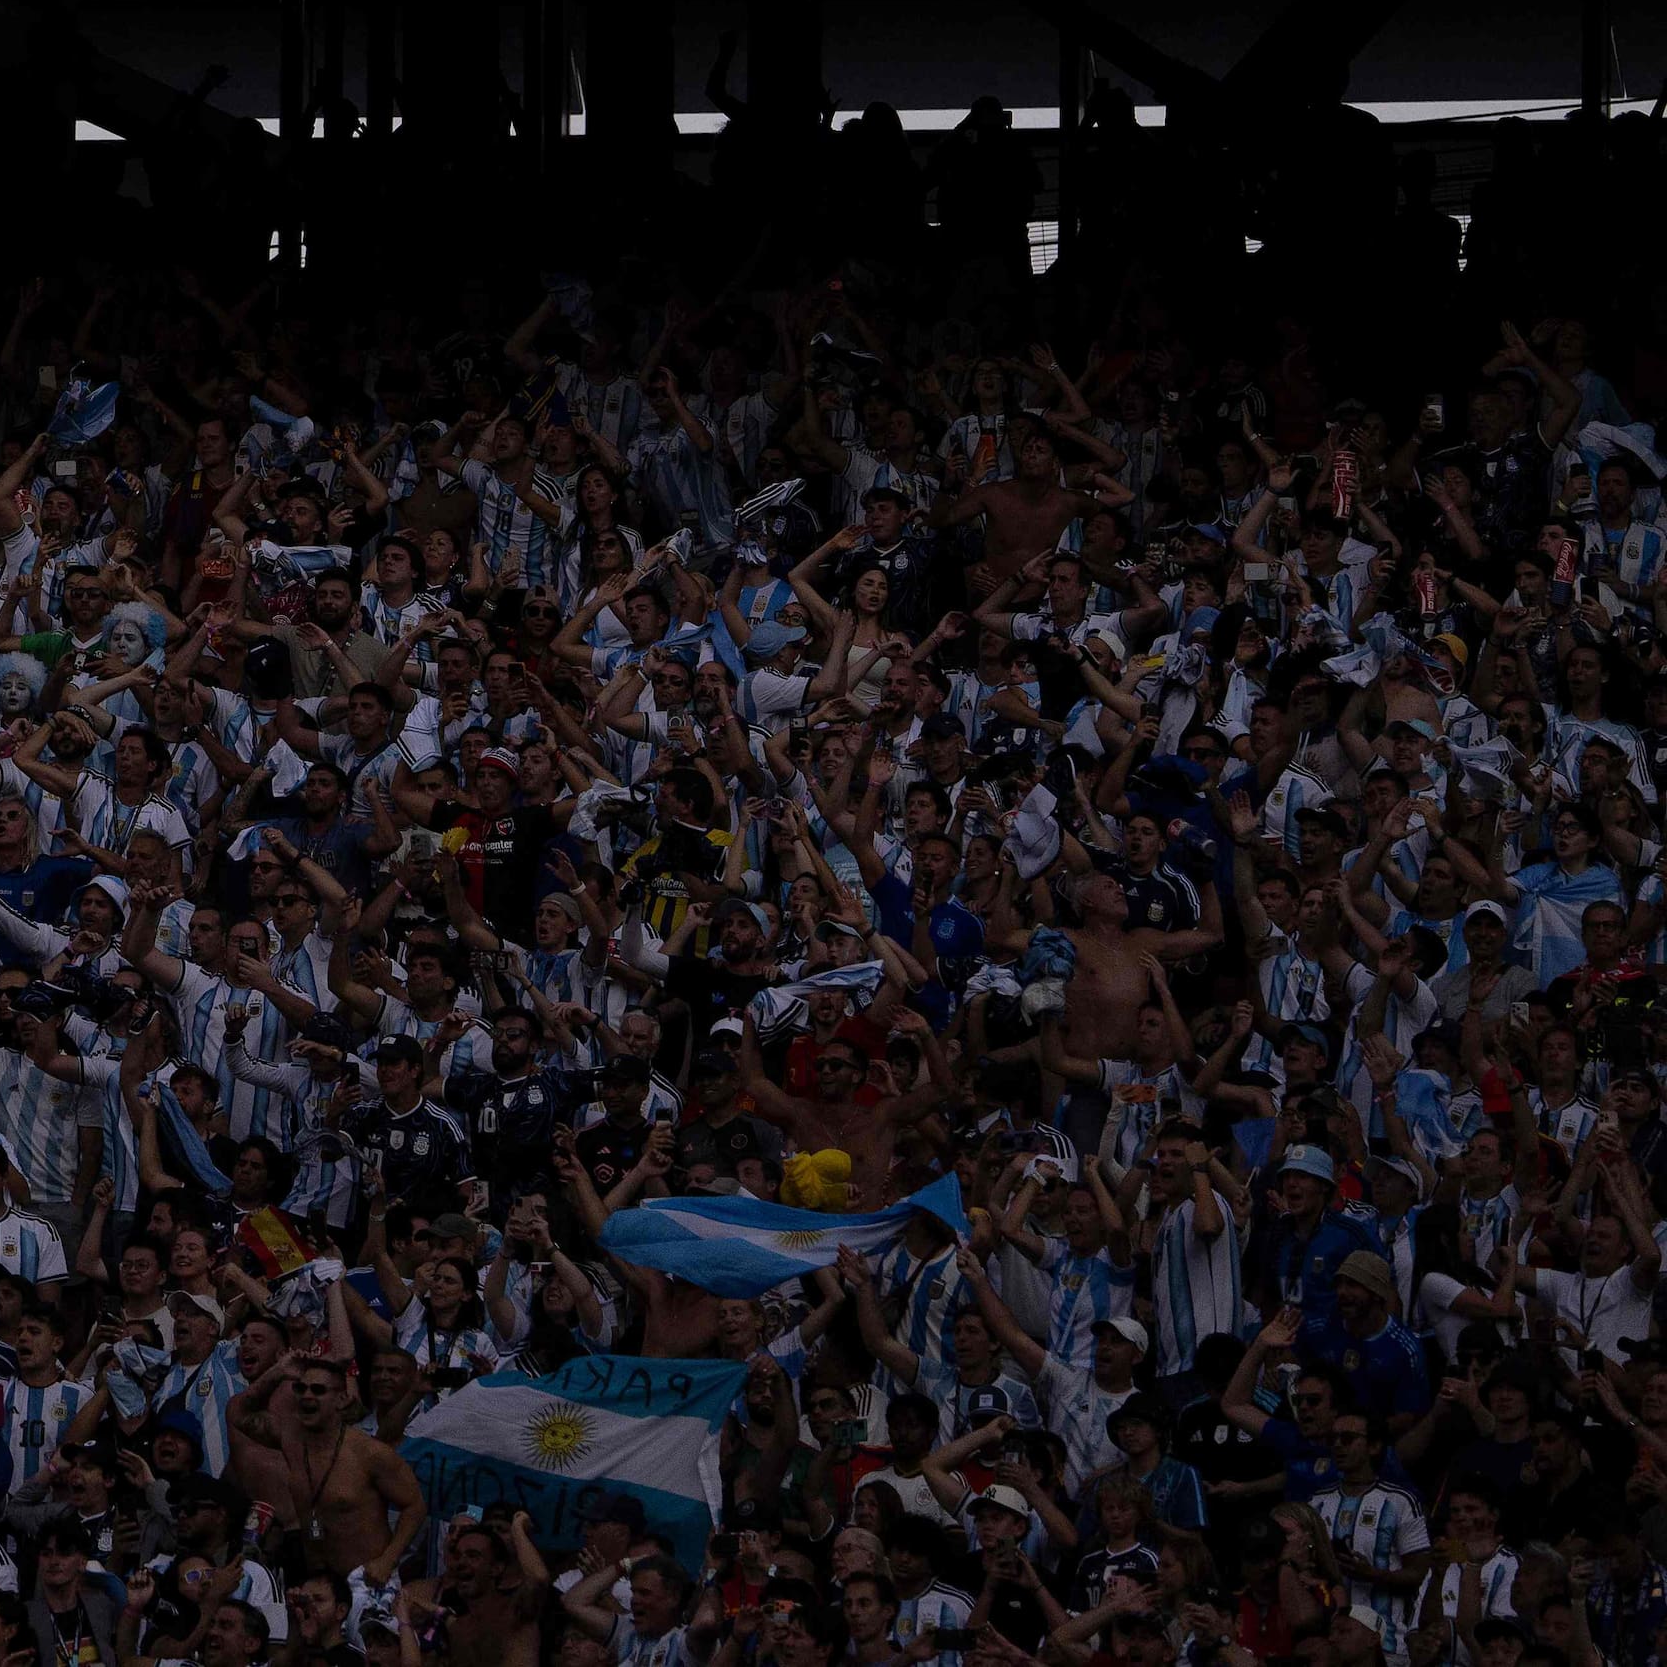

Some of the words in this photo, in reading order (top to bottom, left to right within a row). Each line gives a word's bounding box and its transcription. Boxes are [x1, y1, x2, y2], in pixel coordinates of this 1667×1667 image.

[485, 840, 514, 852] center
[477, 1107, 497, 1133] 10
[19, 1419, 46, 1449] 10
